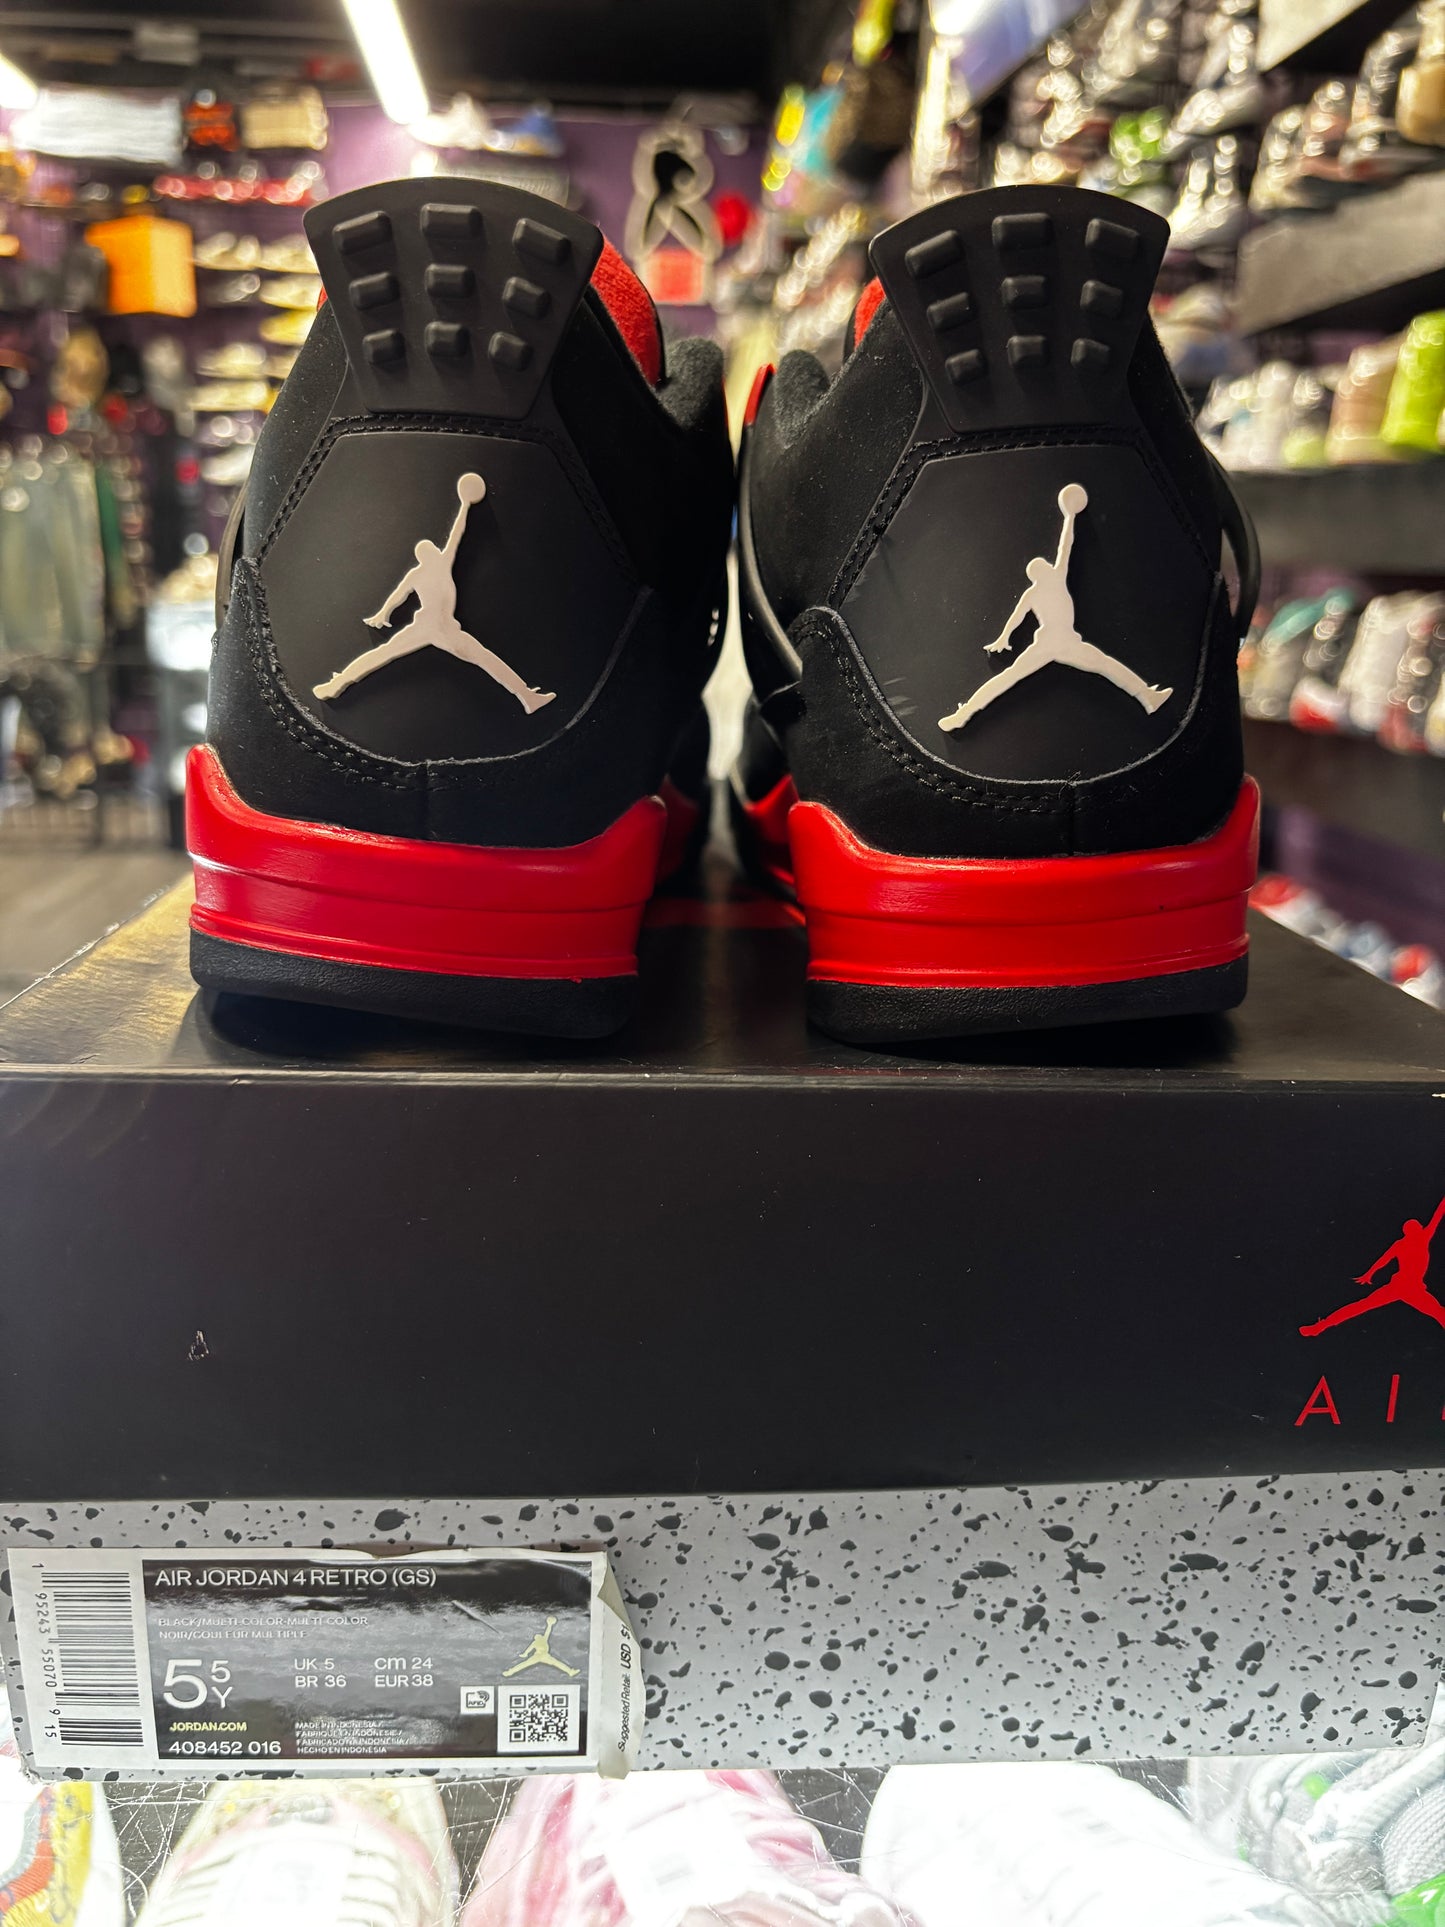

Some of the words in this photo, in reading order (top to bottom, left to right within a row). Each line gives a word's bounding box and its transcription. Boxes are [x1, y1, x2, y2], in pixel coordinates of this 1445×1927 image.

[1294, 1374, 1445, 1427] AI
[155, 1569, 192, 1586] AIR
[196, 1569, 289, 1586] JORDAN
[293, 1569, 306, 1586] 4
[310, 1569, 387, 1585] RETRO
[392, 1568, 436, 1587] (GS)
[35, 1592, 50, 1634] 95243
[159, 1630, 249, 1640] NOIR/COULEUR
[251, 1630, 307, 1639] MULTIPLE
[620, 1643, 632, 1669] USD
[41, 1648, 57, 1688] 55070
[294, 1658, 318, 1670] UK
[324, 1658, 335, 1670] 5
[411, 1657, 433, 1670] 24
[163, 1659, 208, 1709] 5
[211, 1660, 231, 1683] 5
[295, 1675, 318, 1688] BR
[324, 1674, 347, 1687] 36
[375, 1675, 409, 1688] EUR
[411, 1674, 434, 1687] 38
[211, 1686, 233, 1708] Y
[50, 1708, 61, 1716] 9
[44, 1724, 57, 1738] 15
[169, 1722, 247, 1732] JORDAN.COM
[617, 1700, 631, 1752] Suggested
[168, 1741, 243, 1754] 408452
[248, 1741, 281, 1754] 016
[297, 1746, 329, 1754] HECHO
[329, 1746, 340, 1754] EN
[341, 1746, 387, 1754] INDONESIA
